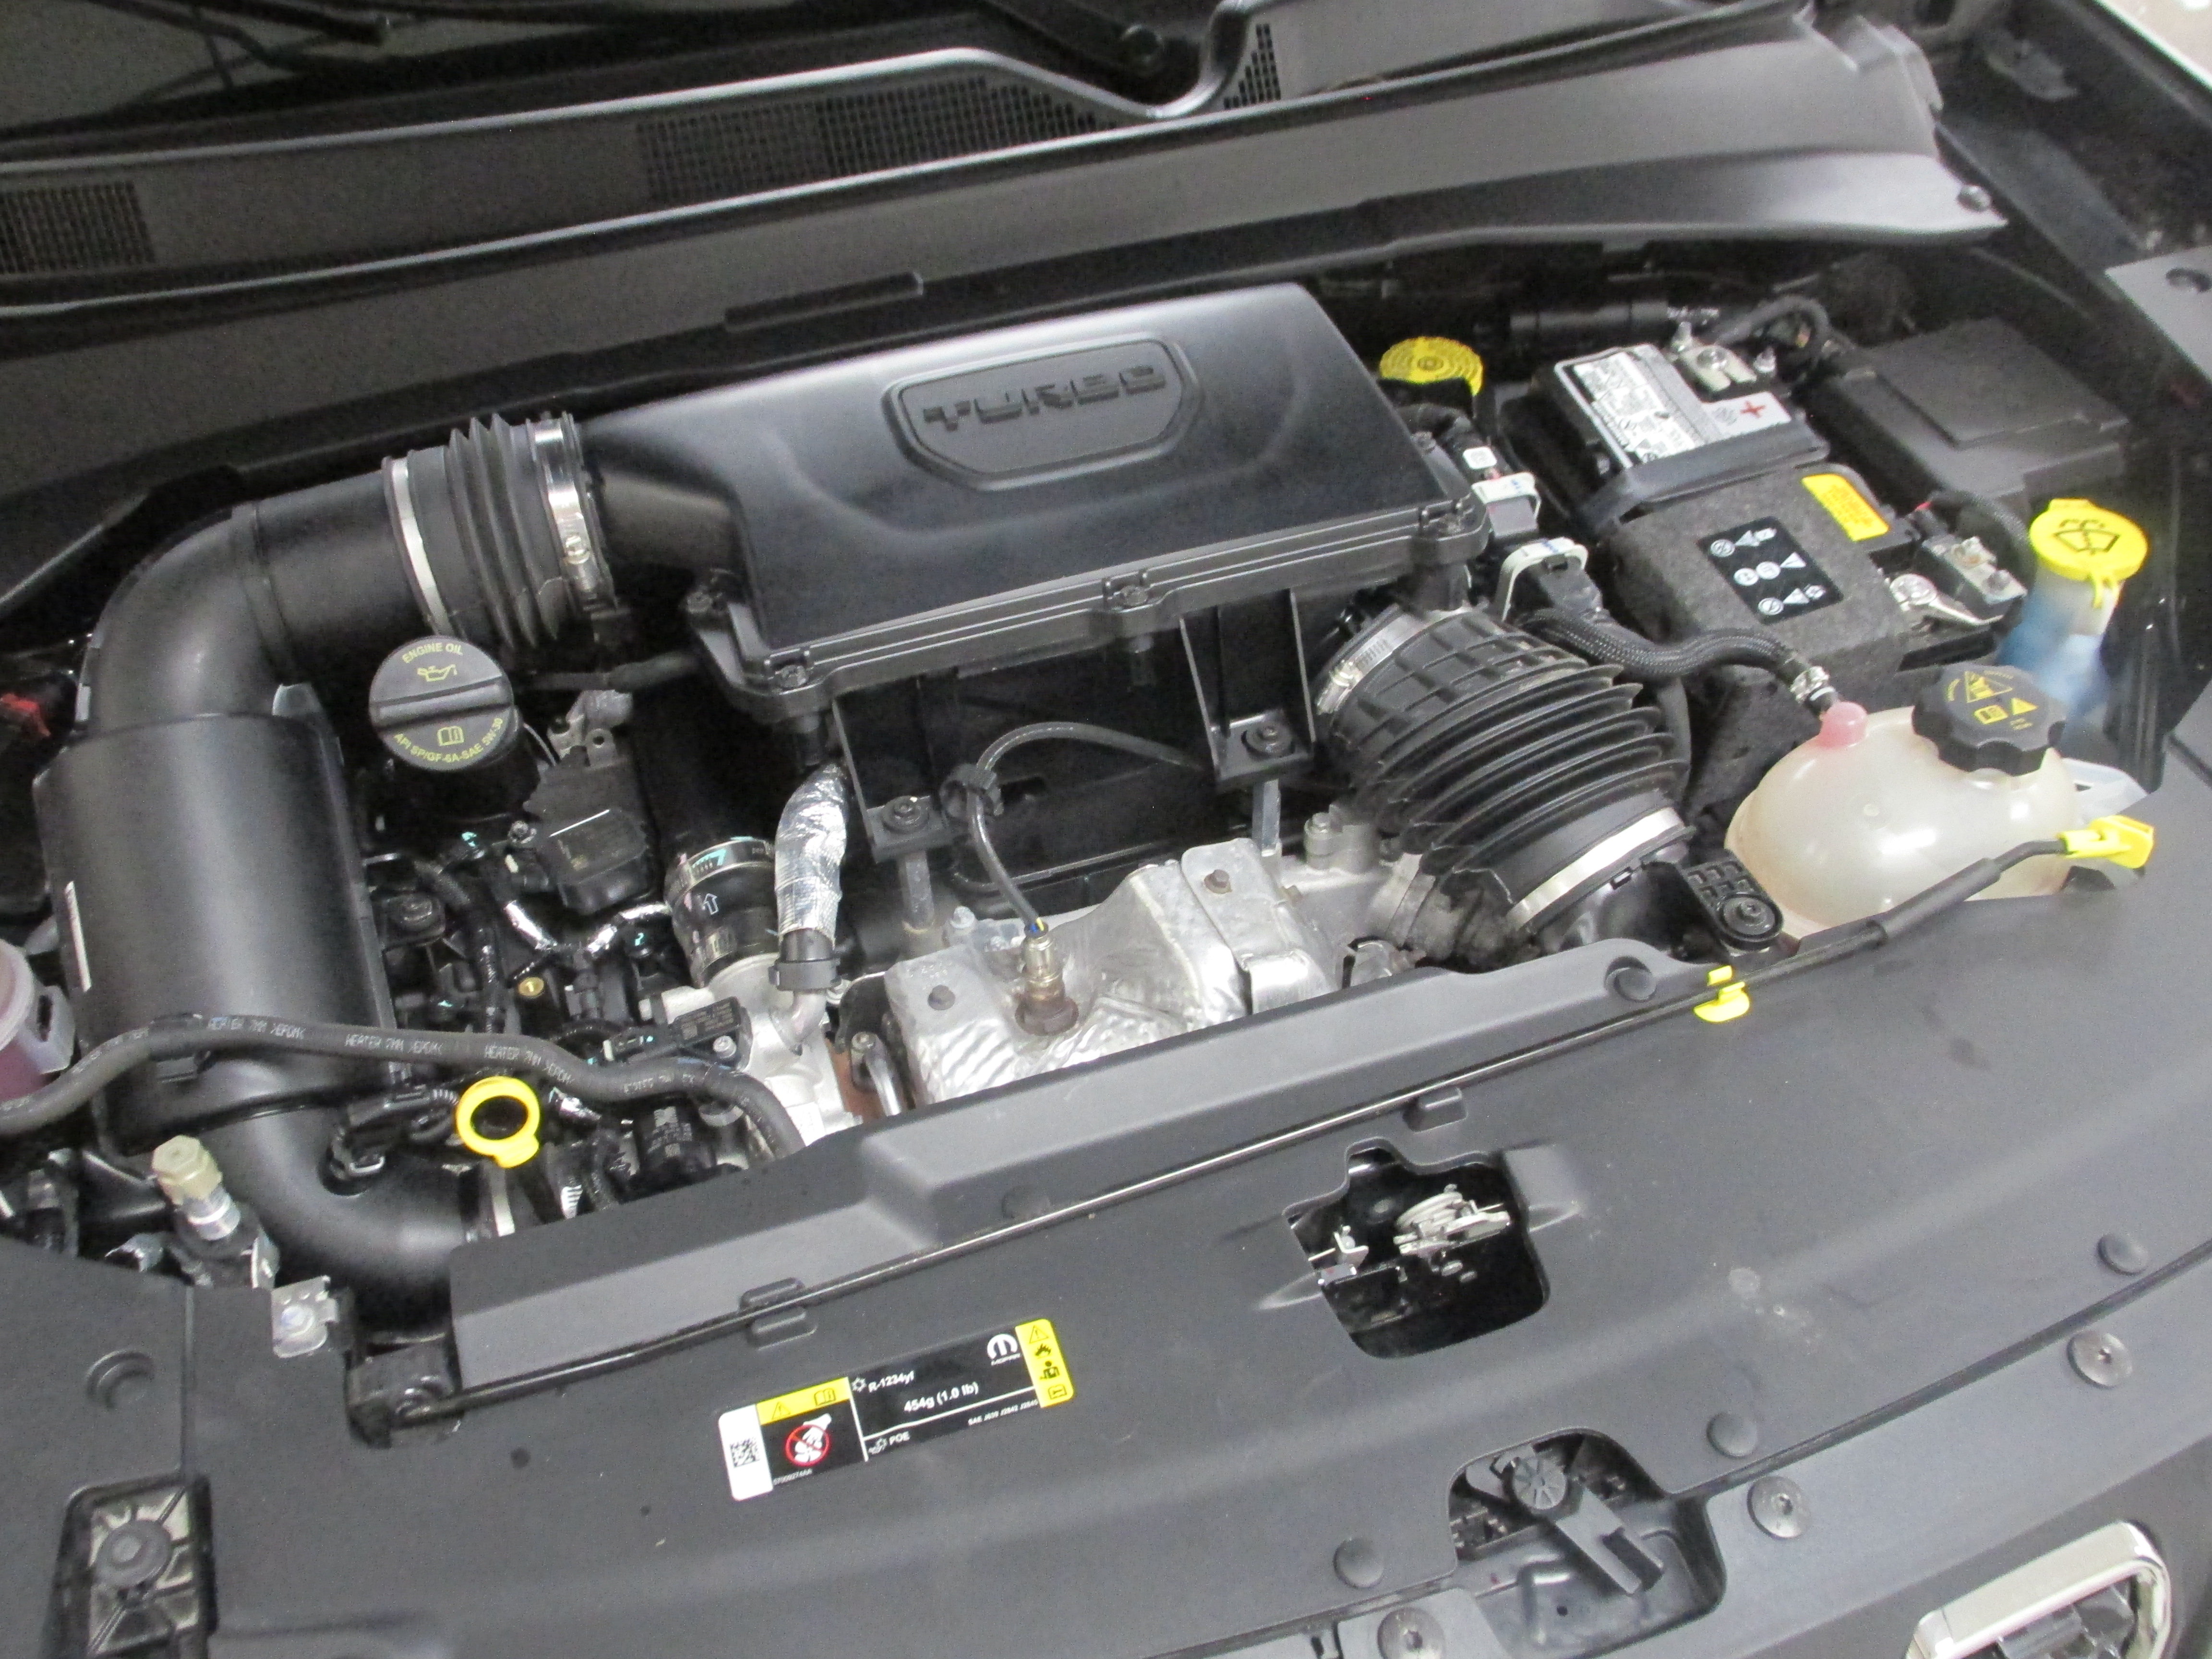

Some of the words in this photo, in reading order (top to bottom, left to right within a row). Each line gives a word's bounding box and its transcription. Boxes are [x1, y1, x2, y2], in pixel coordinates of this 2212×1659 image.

[923, 363, 1166, 432] TURBO
[402, 642, 443, 664] ENGINE
[445, 642, 463, 657] OIL
[394, 733, 412, 750] API
[345, 1033, 381, 1049] HEATER
[484, 1044, 520, 1060] HEATER
[867, 1370, 915, 1393] R-1234yf
[903, 1397, 935, 1413] 454g
[937, 1386, 960, 1406] (1.0
[961, 1381, 979, 1396] lb)
[889, 1431, 911, 1446] POE
